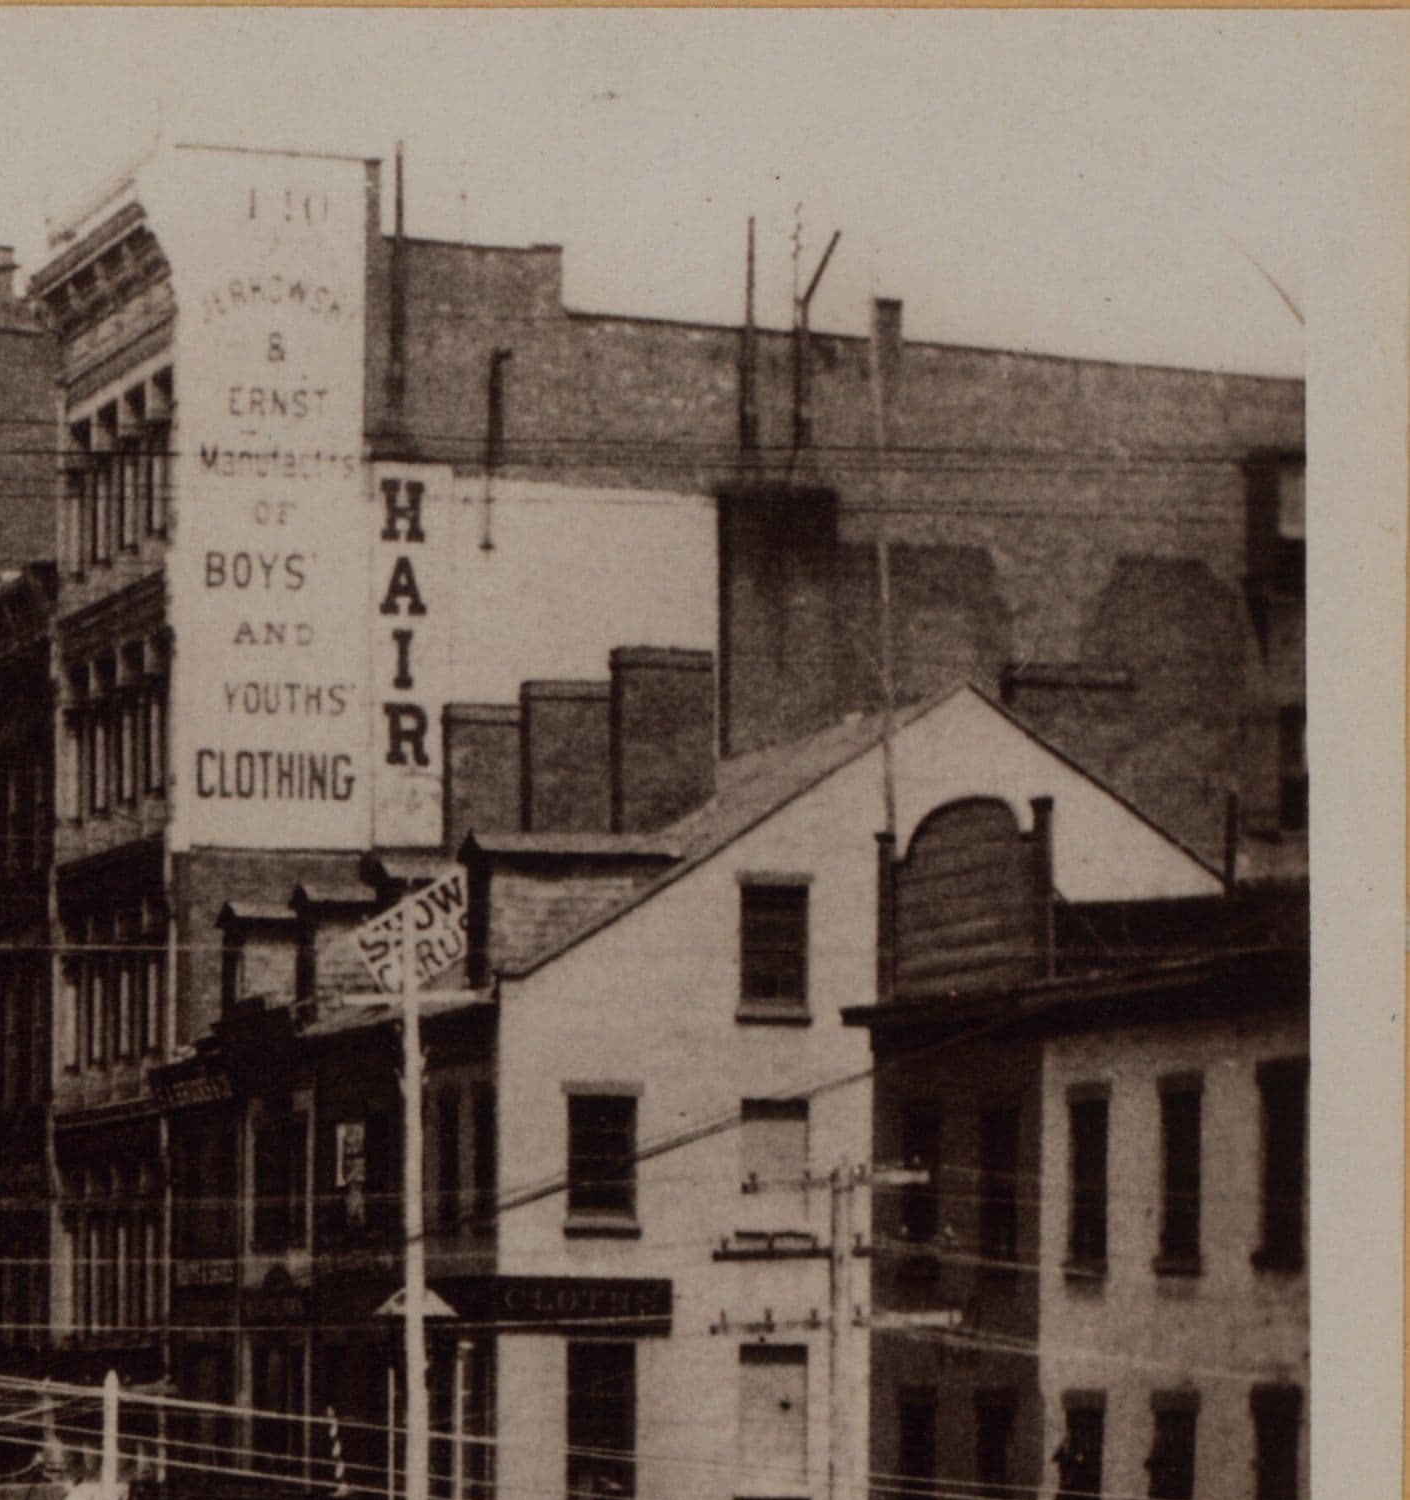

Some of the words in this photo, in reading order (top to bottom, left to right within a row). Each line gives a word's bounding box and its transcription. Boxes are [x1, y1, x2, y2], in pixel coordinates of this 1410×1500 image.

[266, 331, 288, 363] &
[227, 386, 329, 418] ERNST
[253, 500, 297, 525] OF
[232, 621, 314, 646] AND
[380, 477, 431, 768] HAIR
[196, 748, 356, 801] CLOTHING
